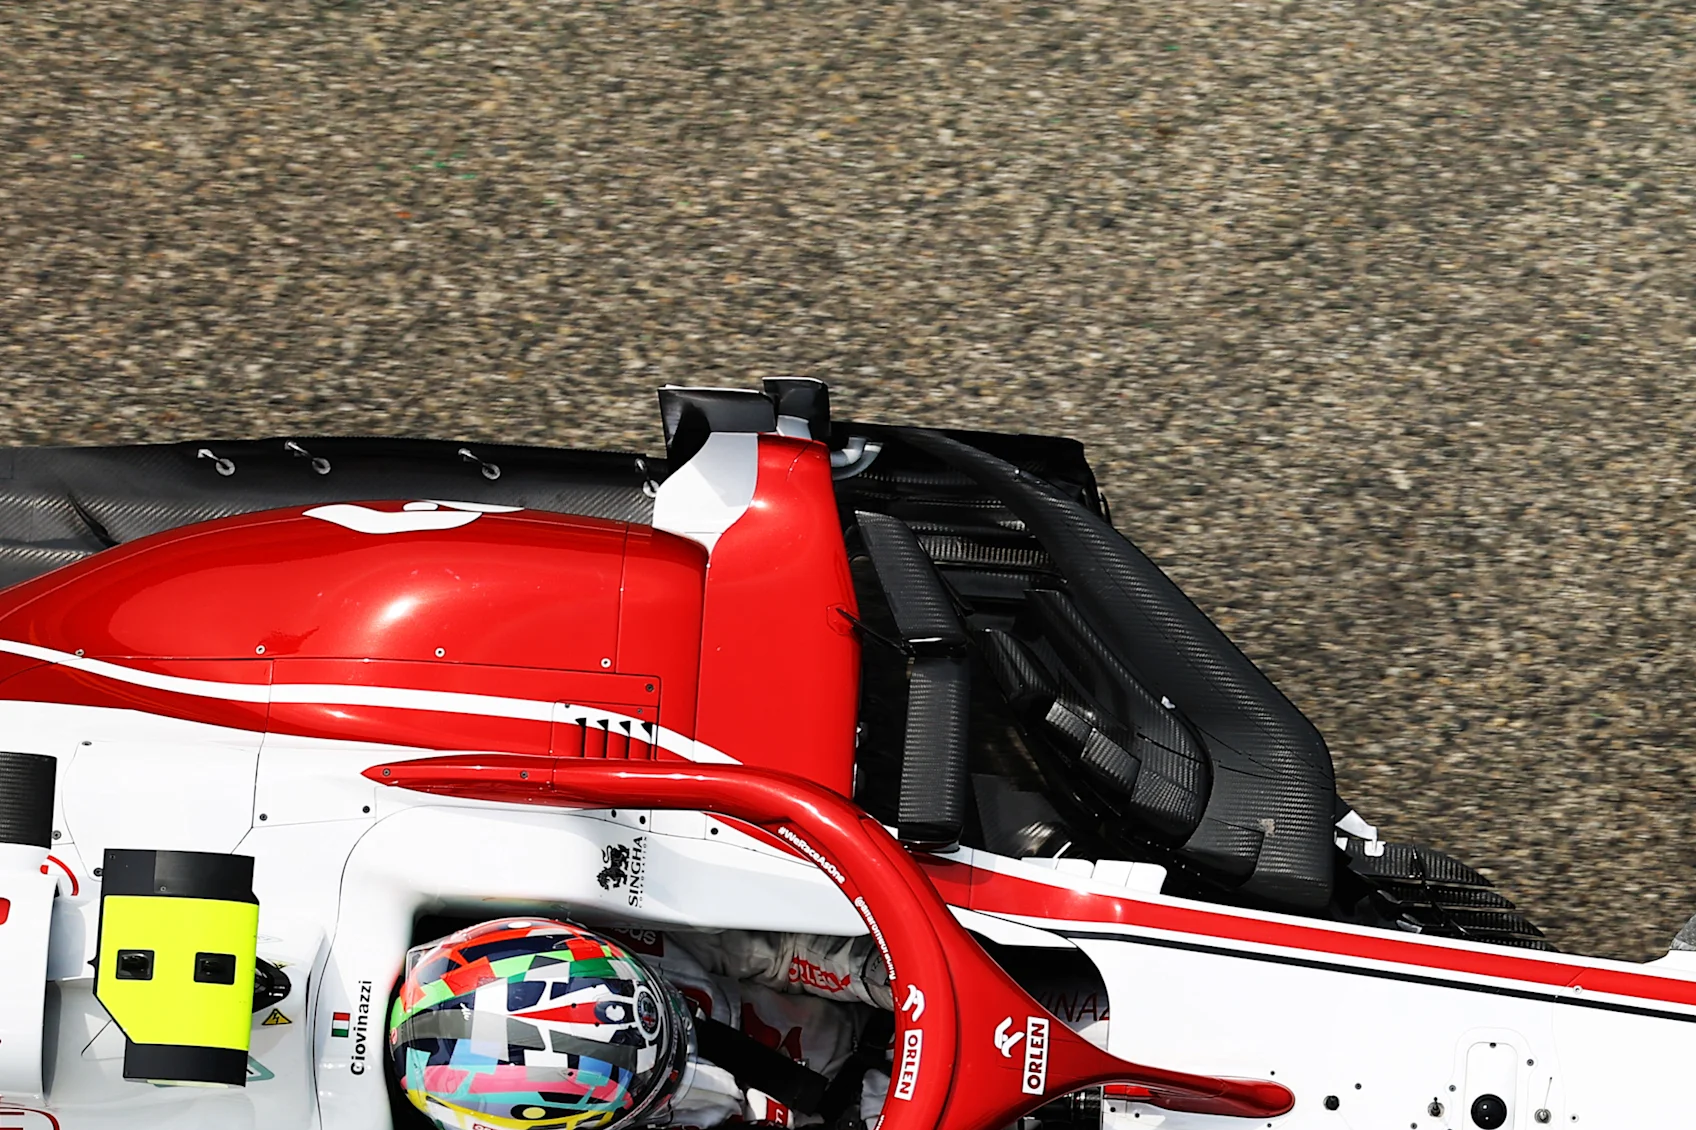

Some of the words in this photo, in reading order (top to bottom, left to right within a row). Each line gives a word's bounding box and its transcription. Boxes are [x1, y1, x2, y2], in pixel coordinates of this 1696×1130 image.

[628, 836, 643, 907] SINGHA
[778, 826, 845, 884] #WeRaceAsOne
[350, 980, 373, 1076] Giovinazzi
[1027, 1022, 1045, 1091] ORLEN
[900, 1033, 919, 1095] ORLEN
